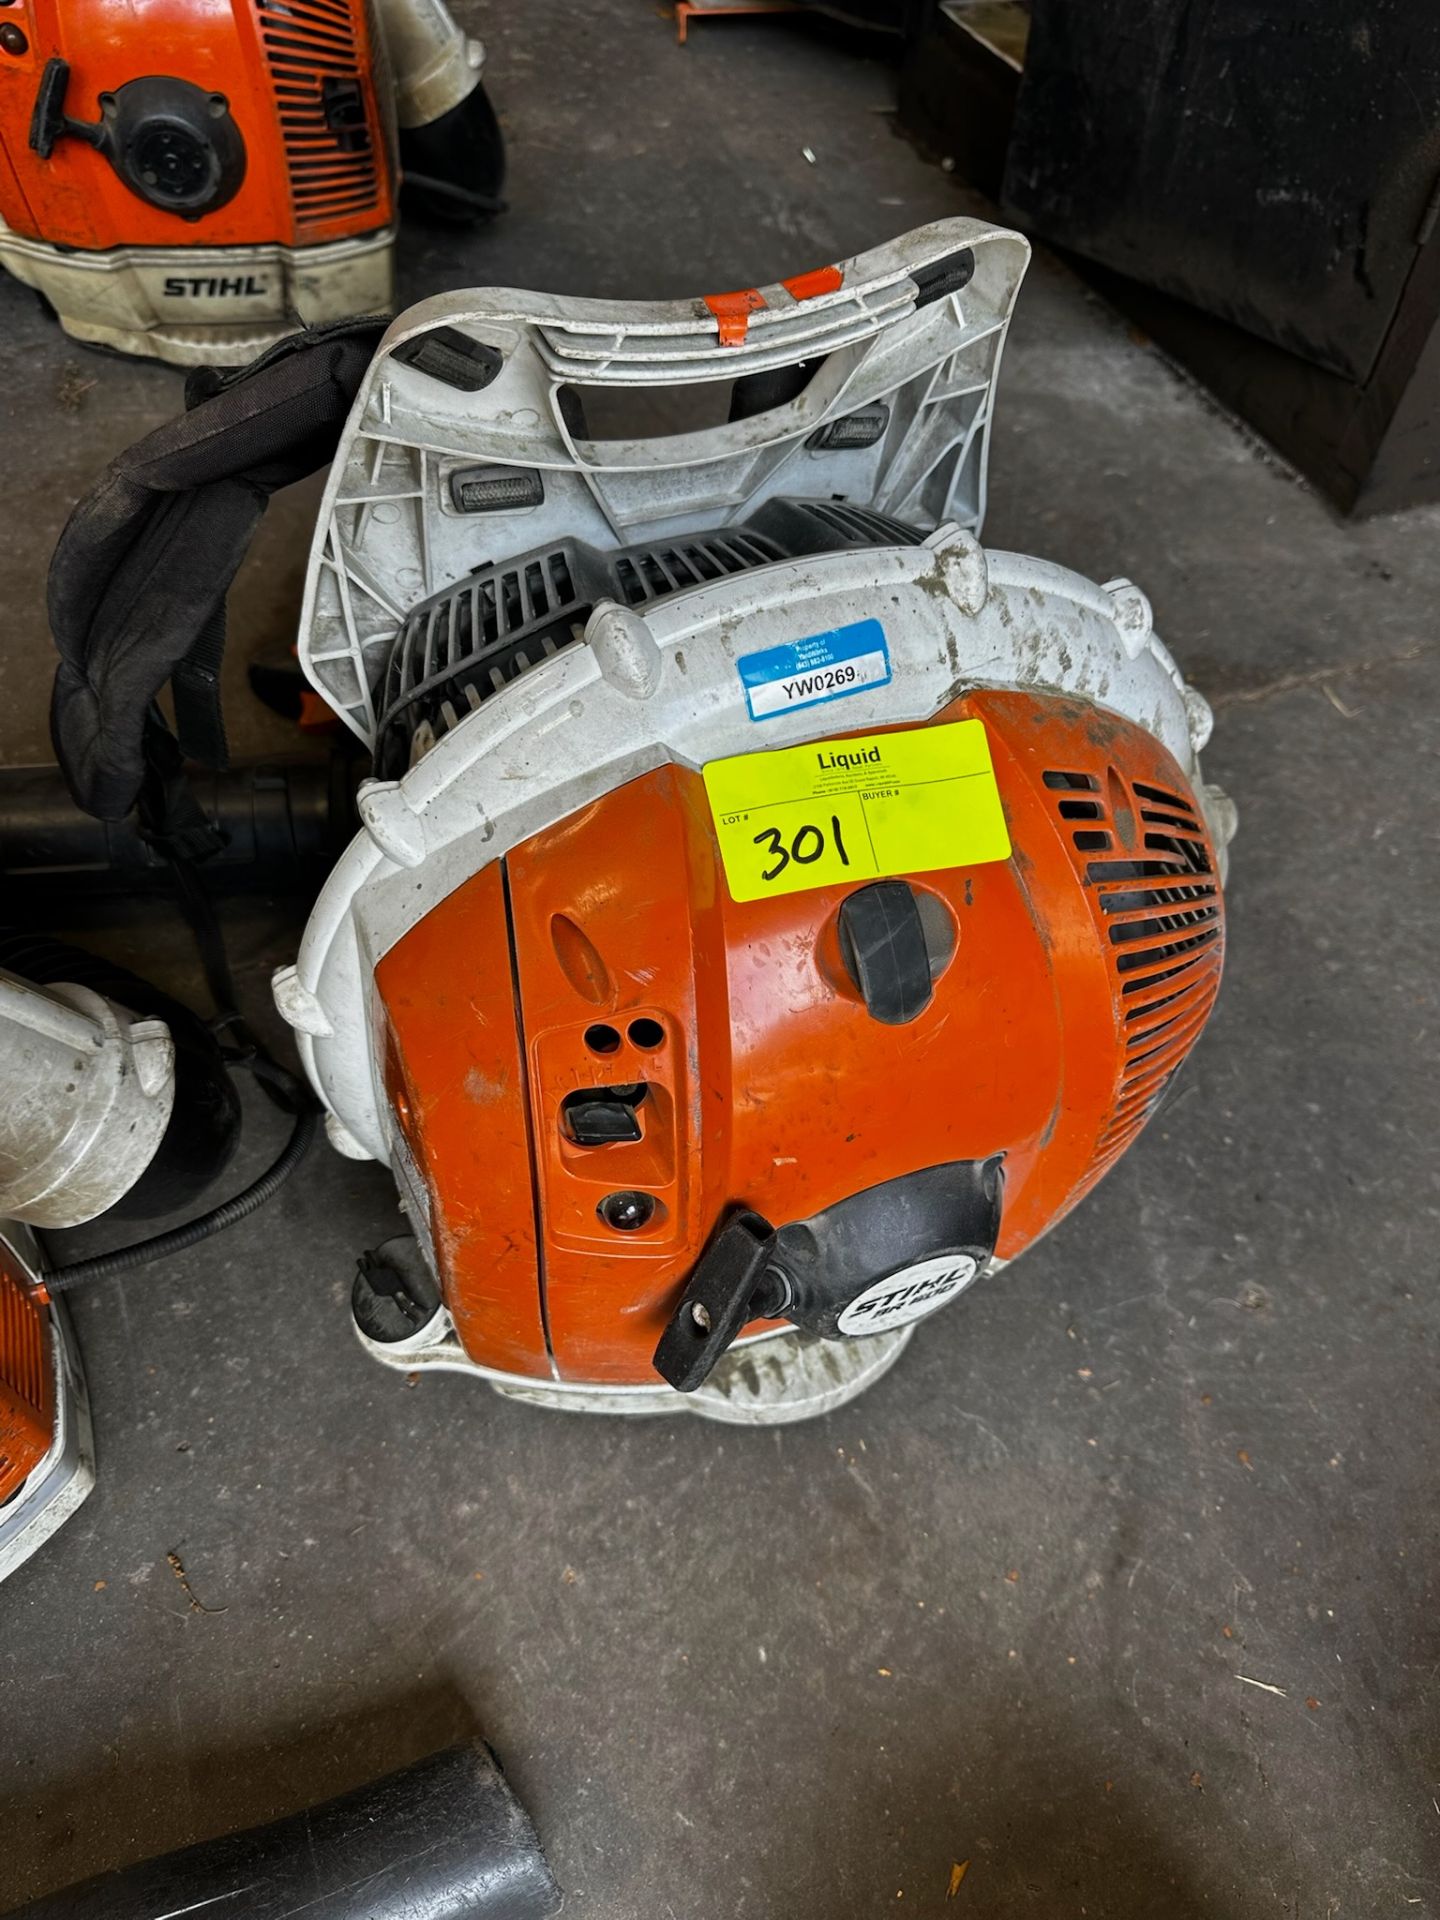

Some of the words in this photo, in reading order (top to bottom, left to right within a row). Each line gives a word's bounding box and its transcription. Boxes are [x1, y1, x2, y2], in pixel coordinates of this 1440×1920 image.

[163, 276, 267, 296] STIHL
[782, 666, 855, 700] YW0269
[817, 746, 881, 770] Liquid
[862, 790, 893, 800] BUYER
[722, 815, 741, 825] LOT
[753, 815, 849, 881] 301
[848, 1268, 966, 1319] STIHL
